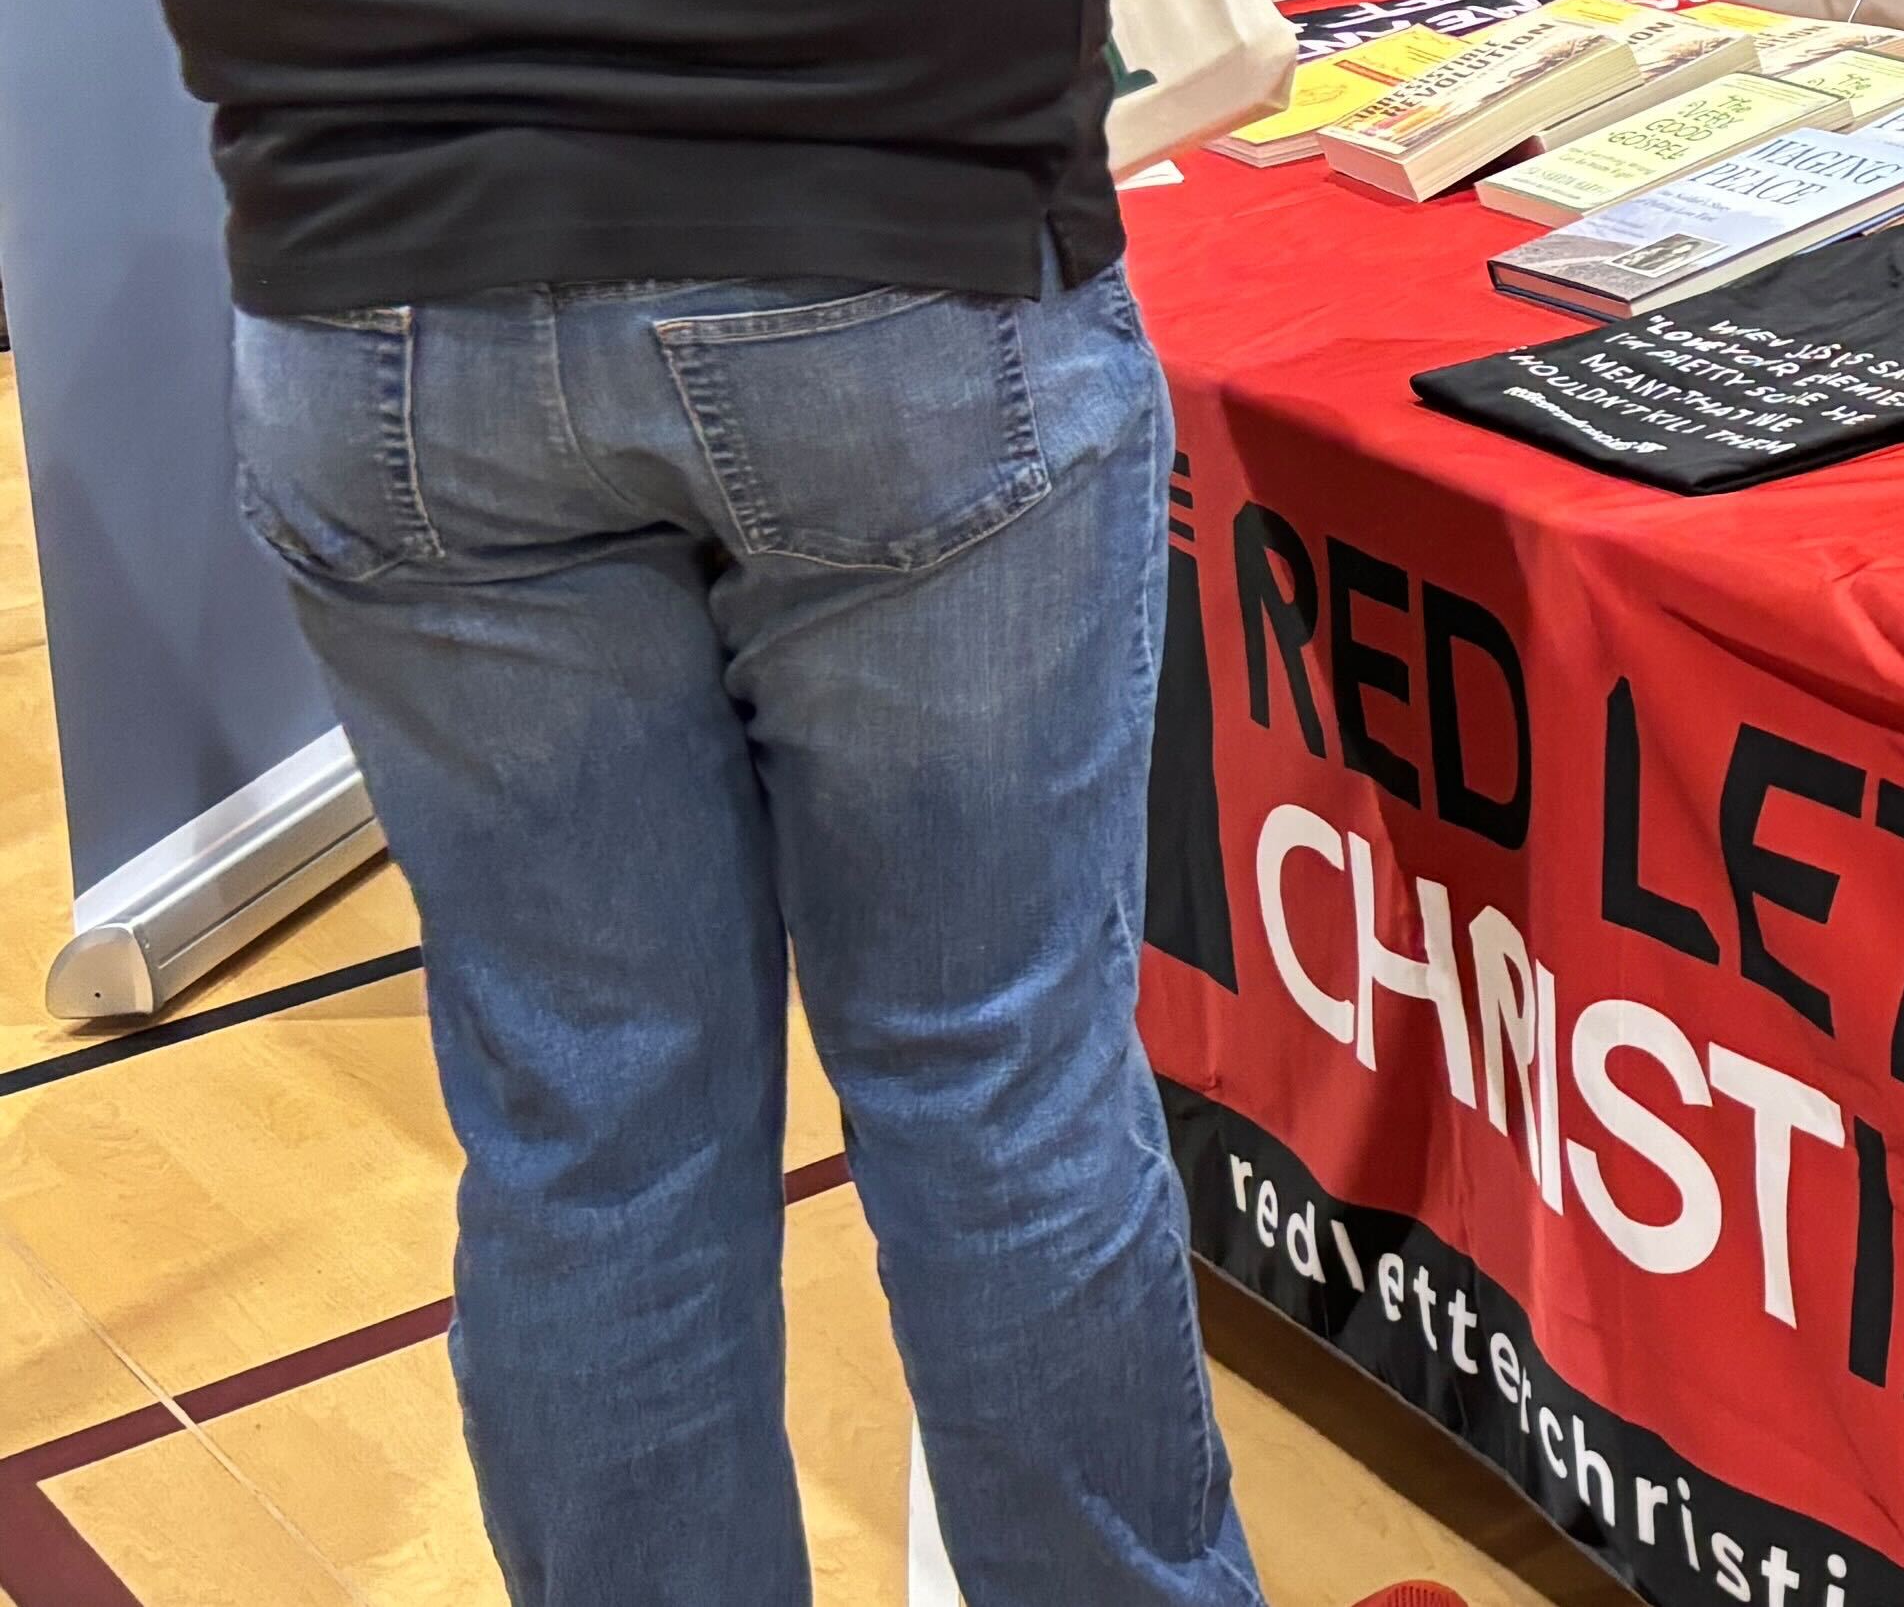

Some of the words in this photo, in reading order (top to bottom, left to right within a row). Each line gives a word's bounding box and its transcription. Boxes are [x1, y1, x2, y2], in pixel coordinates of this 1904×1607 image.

[1381, 21, 1557, 119] REVOLUTION
[1677, 98, 1745, 130] VERY
[1718, 94, 1753, 114] The
[1607, 130, 1690, 161] GOSPEL
[1644, 117, 1714, 142] GOOD
[1687, 162, 1829, 207] PEACE
[1746, 138, 1903, 188] WAGING
[1579, 353, 1683, 402] MEANT
[1680, 390, 1757, 424] THAT
[1753, 409, 1805, 435] WE
[1648, 345, 1750, 389] PRETTY
[1822, 404, 1878, 427] HE
[1706, 427, 1799, 457] THEM
[1232, 499, 1531, 852] RED
